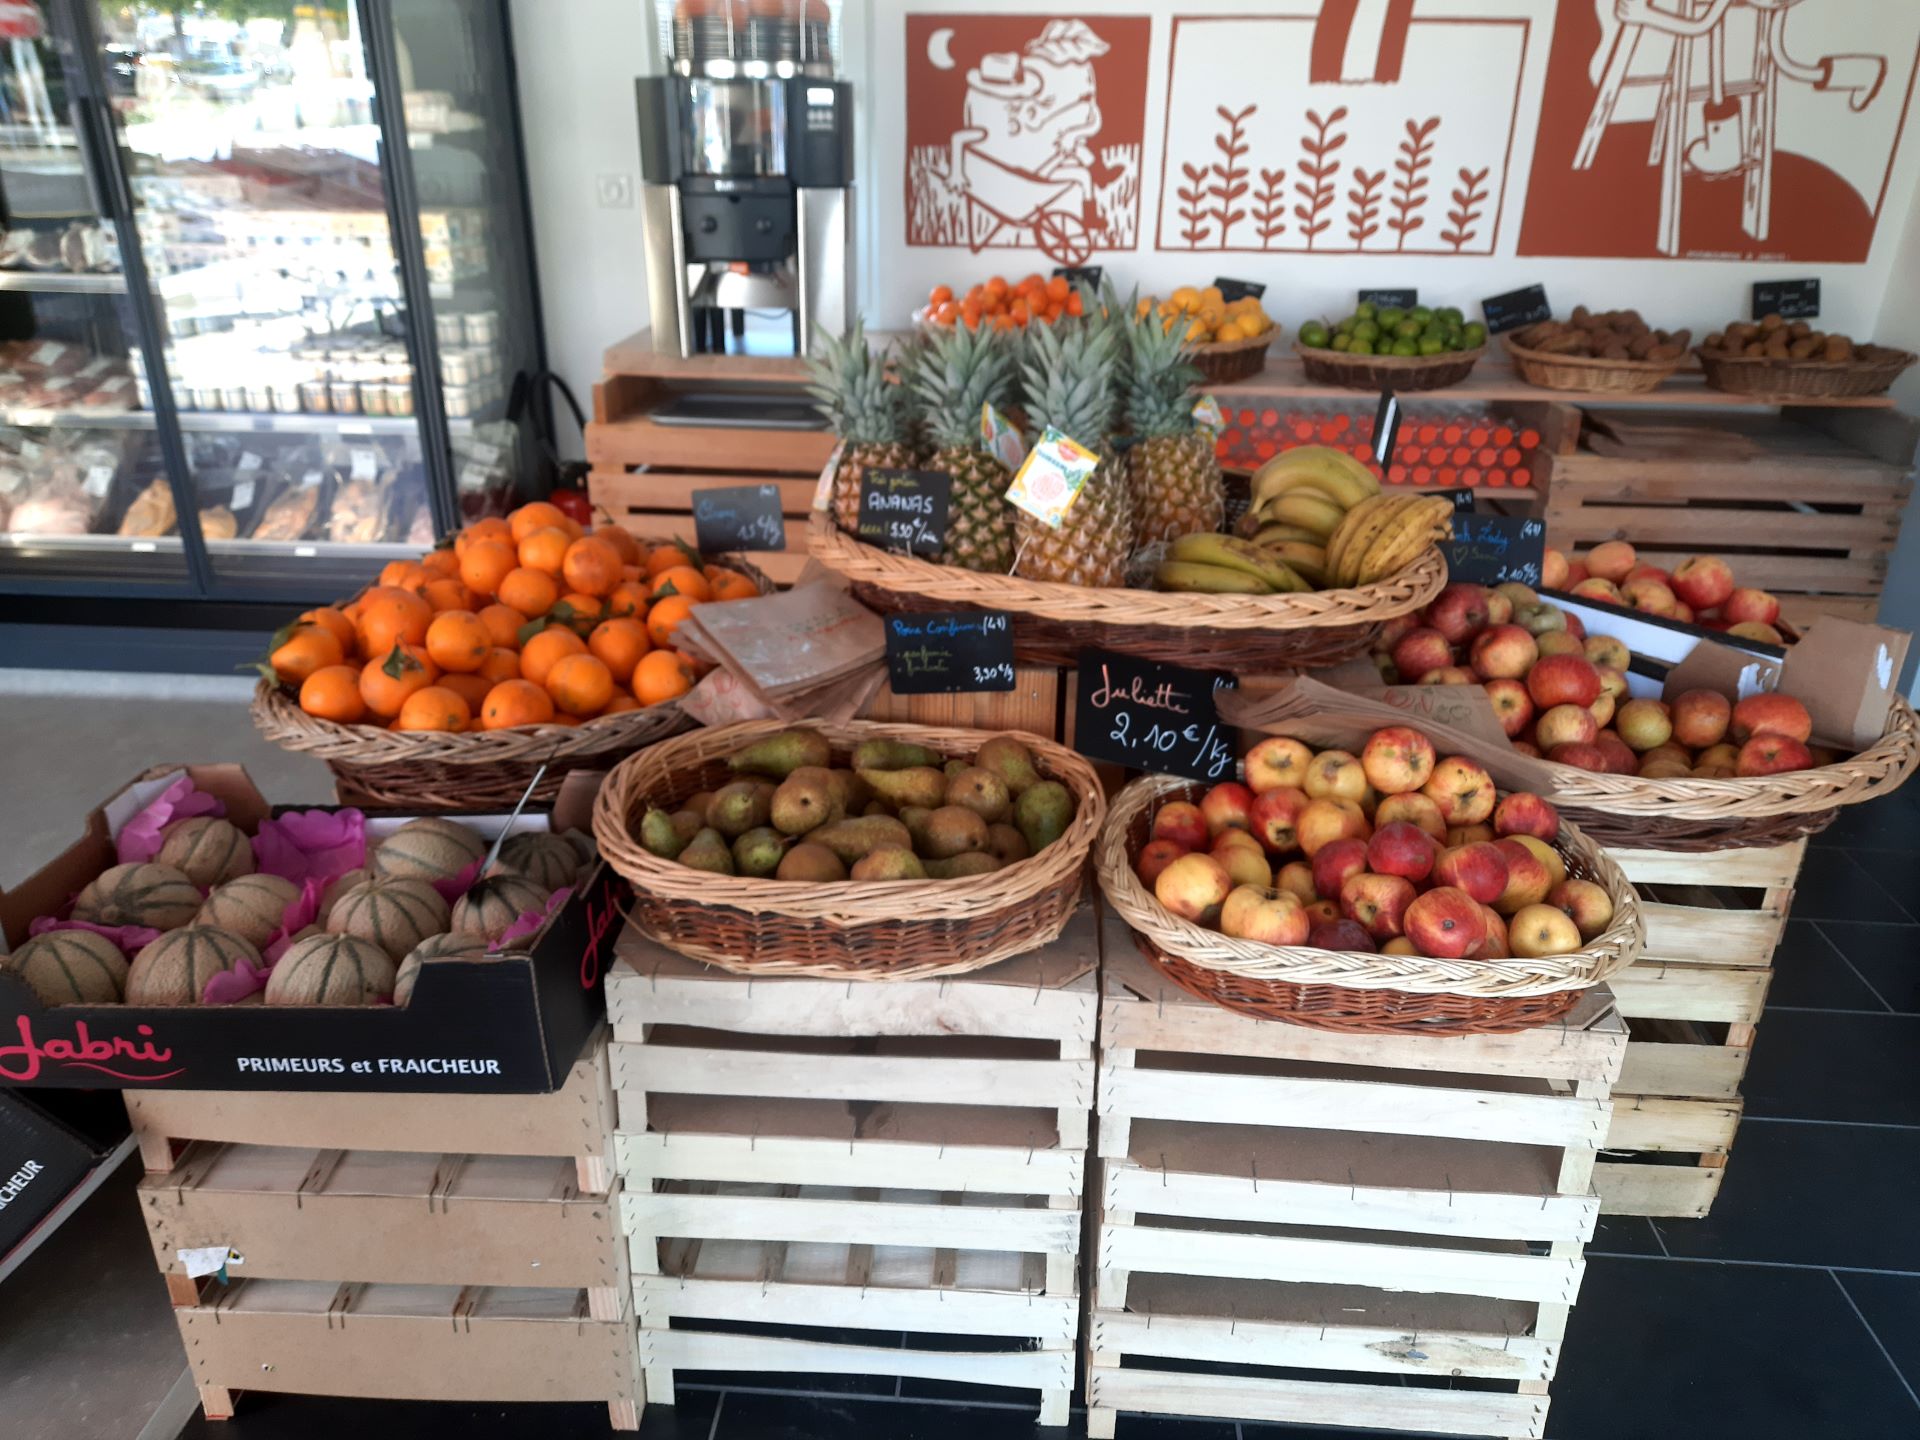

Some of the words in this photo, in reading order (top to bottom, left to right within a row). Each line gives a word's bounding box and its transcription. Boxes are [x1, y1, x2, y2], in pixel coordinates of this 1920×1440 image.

[867, 491, 934, 515] ANANAS
[1091, 663, 1192, 714] Juliette
[237, 1057, 345, 1073] PRIMEURS
[351, 1059, 372, 1073] et
[379, 1058, 501, 1075] FRAICHEUR
